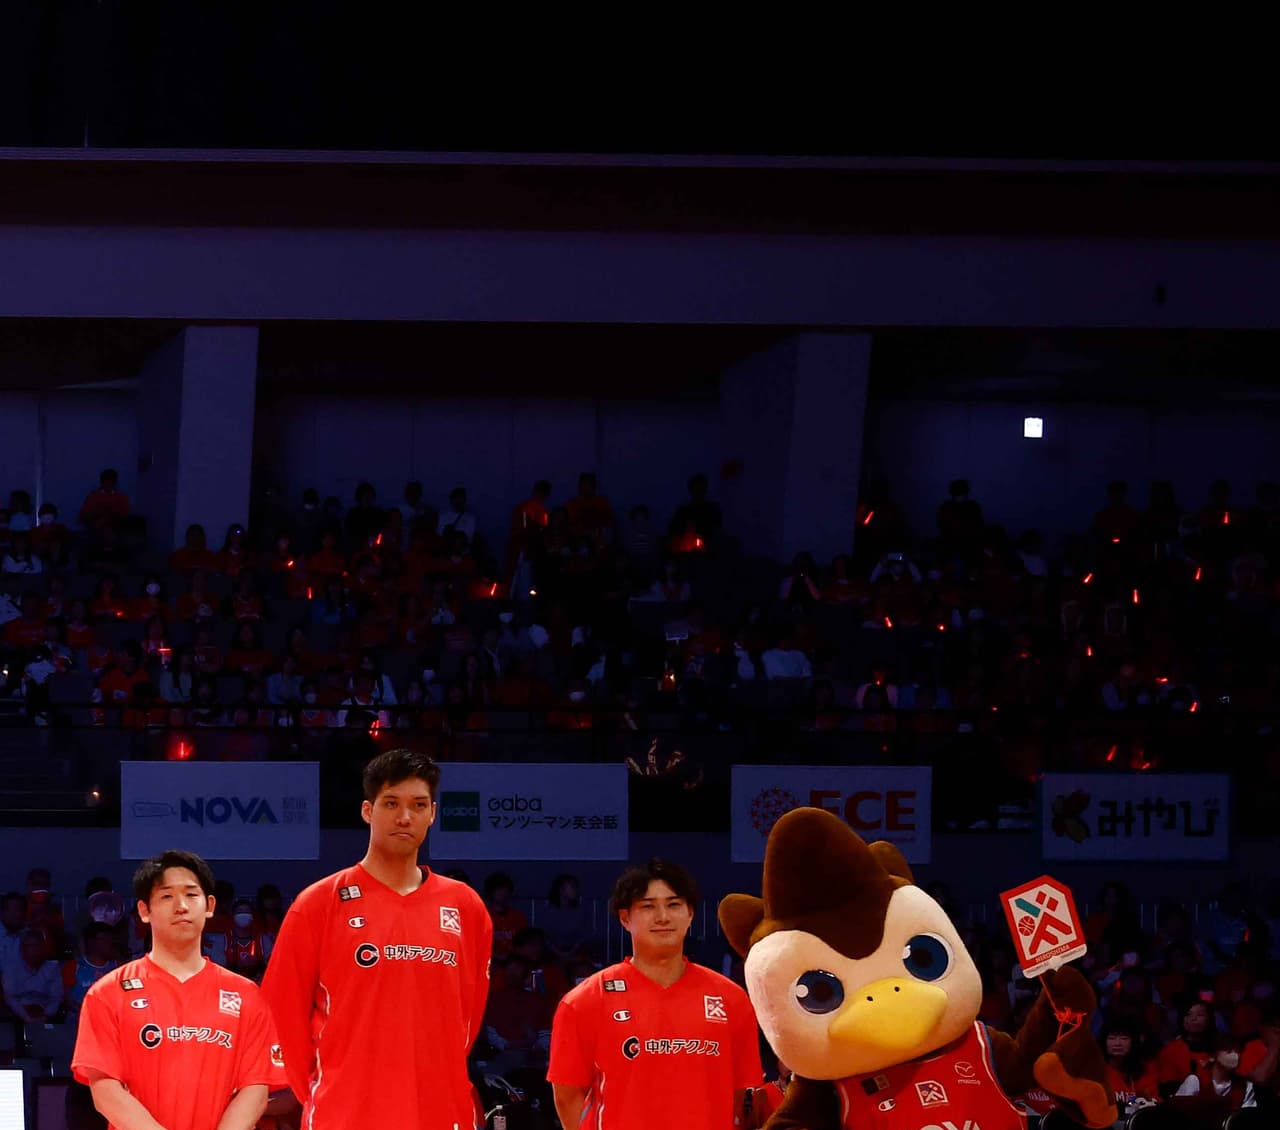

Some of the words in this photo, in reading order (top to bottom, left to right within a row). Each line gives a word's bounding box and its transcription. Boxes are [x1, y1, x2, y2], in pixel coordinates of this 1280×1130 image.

[180, 797, 278, 826] NOVA
[488, 815, 618, 830] マンツーマン英会話
[1098, 796, 1220, 837] みやび
[384, 945, 457, 967] 中外テクノス
[645, 1039, 720, 1056] 中外テクノス
